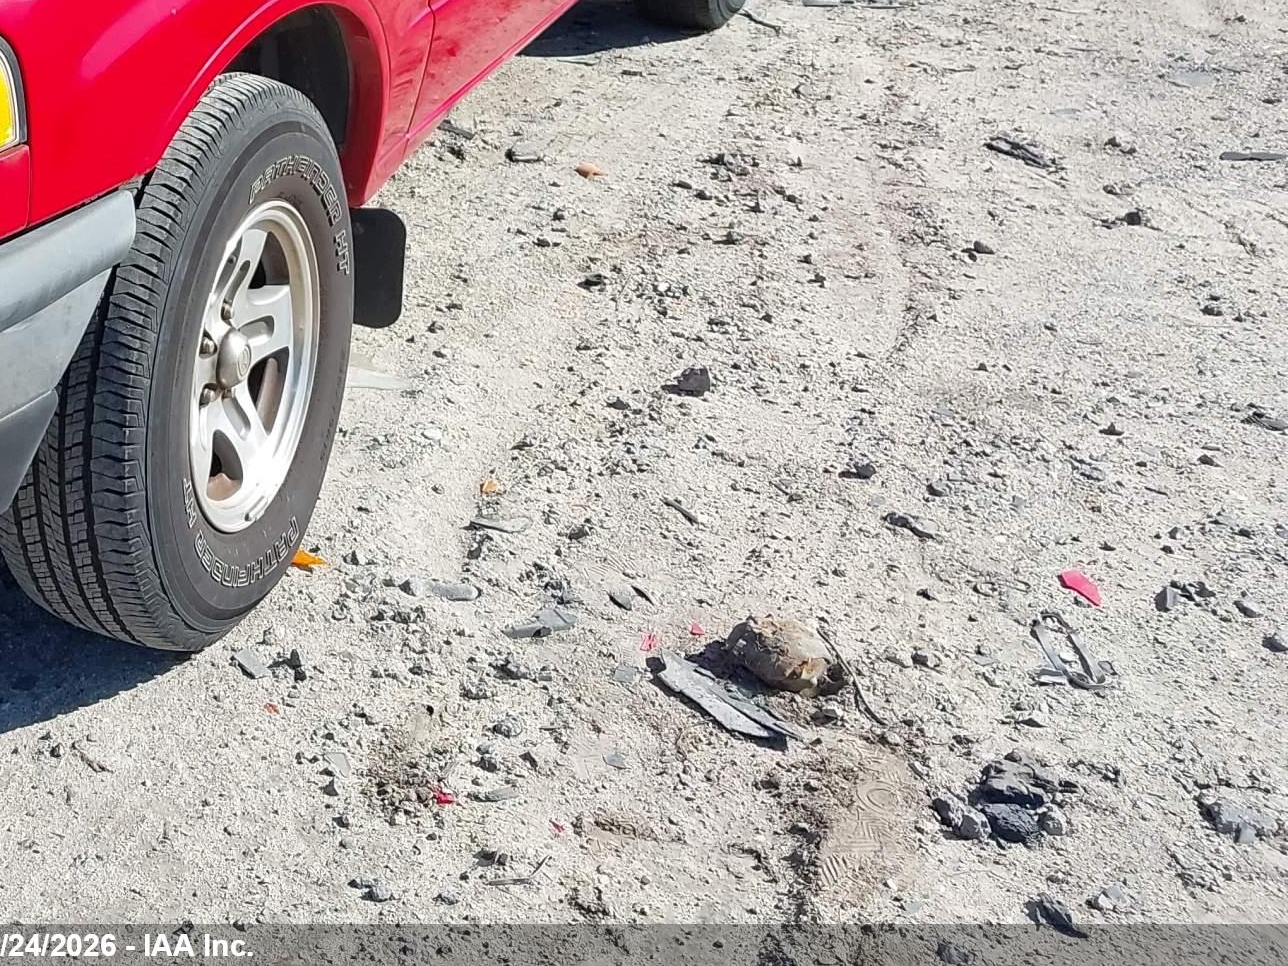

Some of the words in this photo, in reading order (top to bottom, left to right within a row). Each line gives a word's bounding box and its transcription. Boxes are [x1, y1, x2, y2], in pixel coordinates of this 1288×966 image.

[249, 154, 343, 226] PATHFINDER
[334, 230, 350, 275] HT
[182, 478, 197, 529] HT
[194, 516, 300, 587] PATHFINDER
